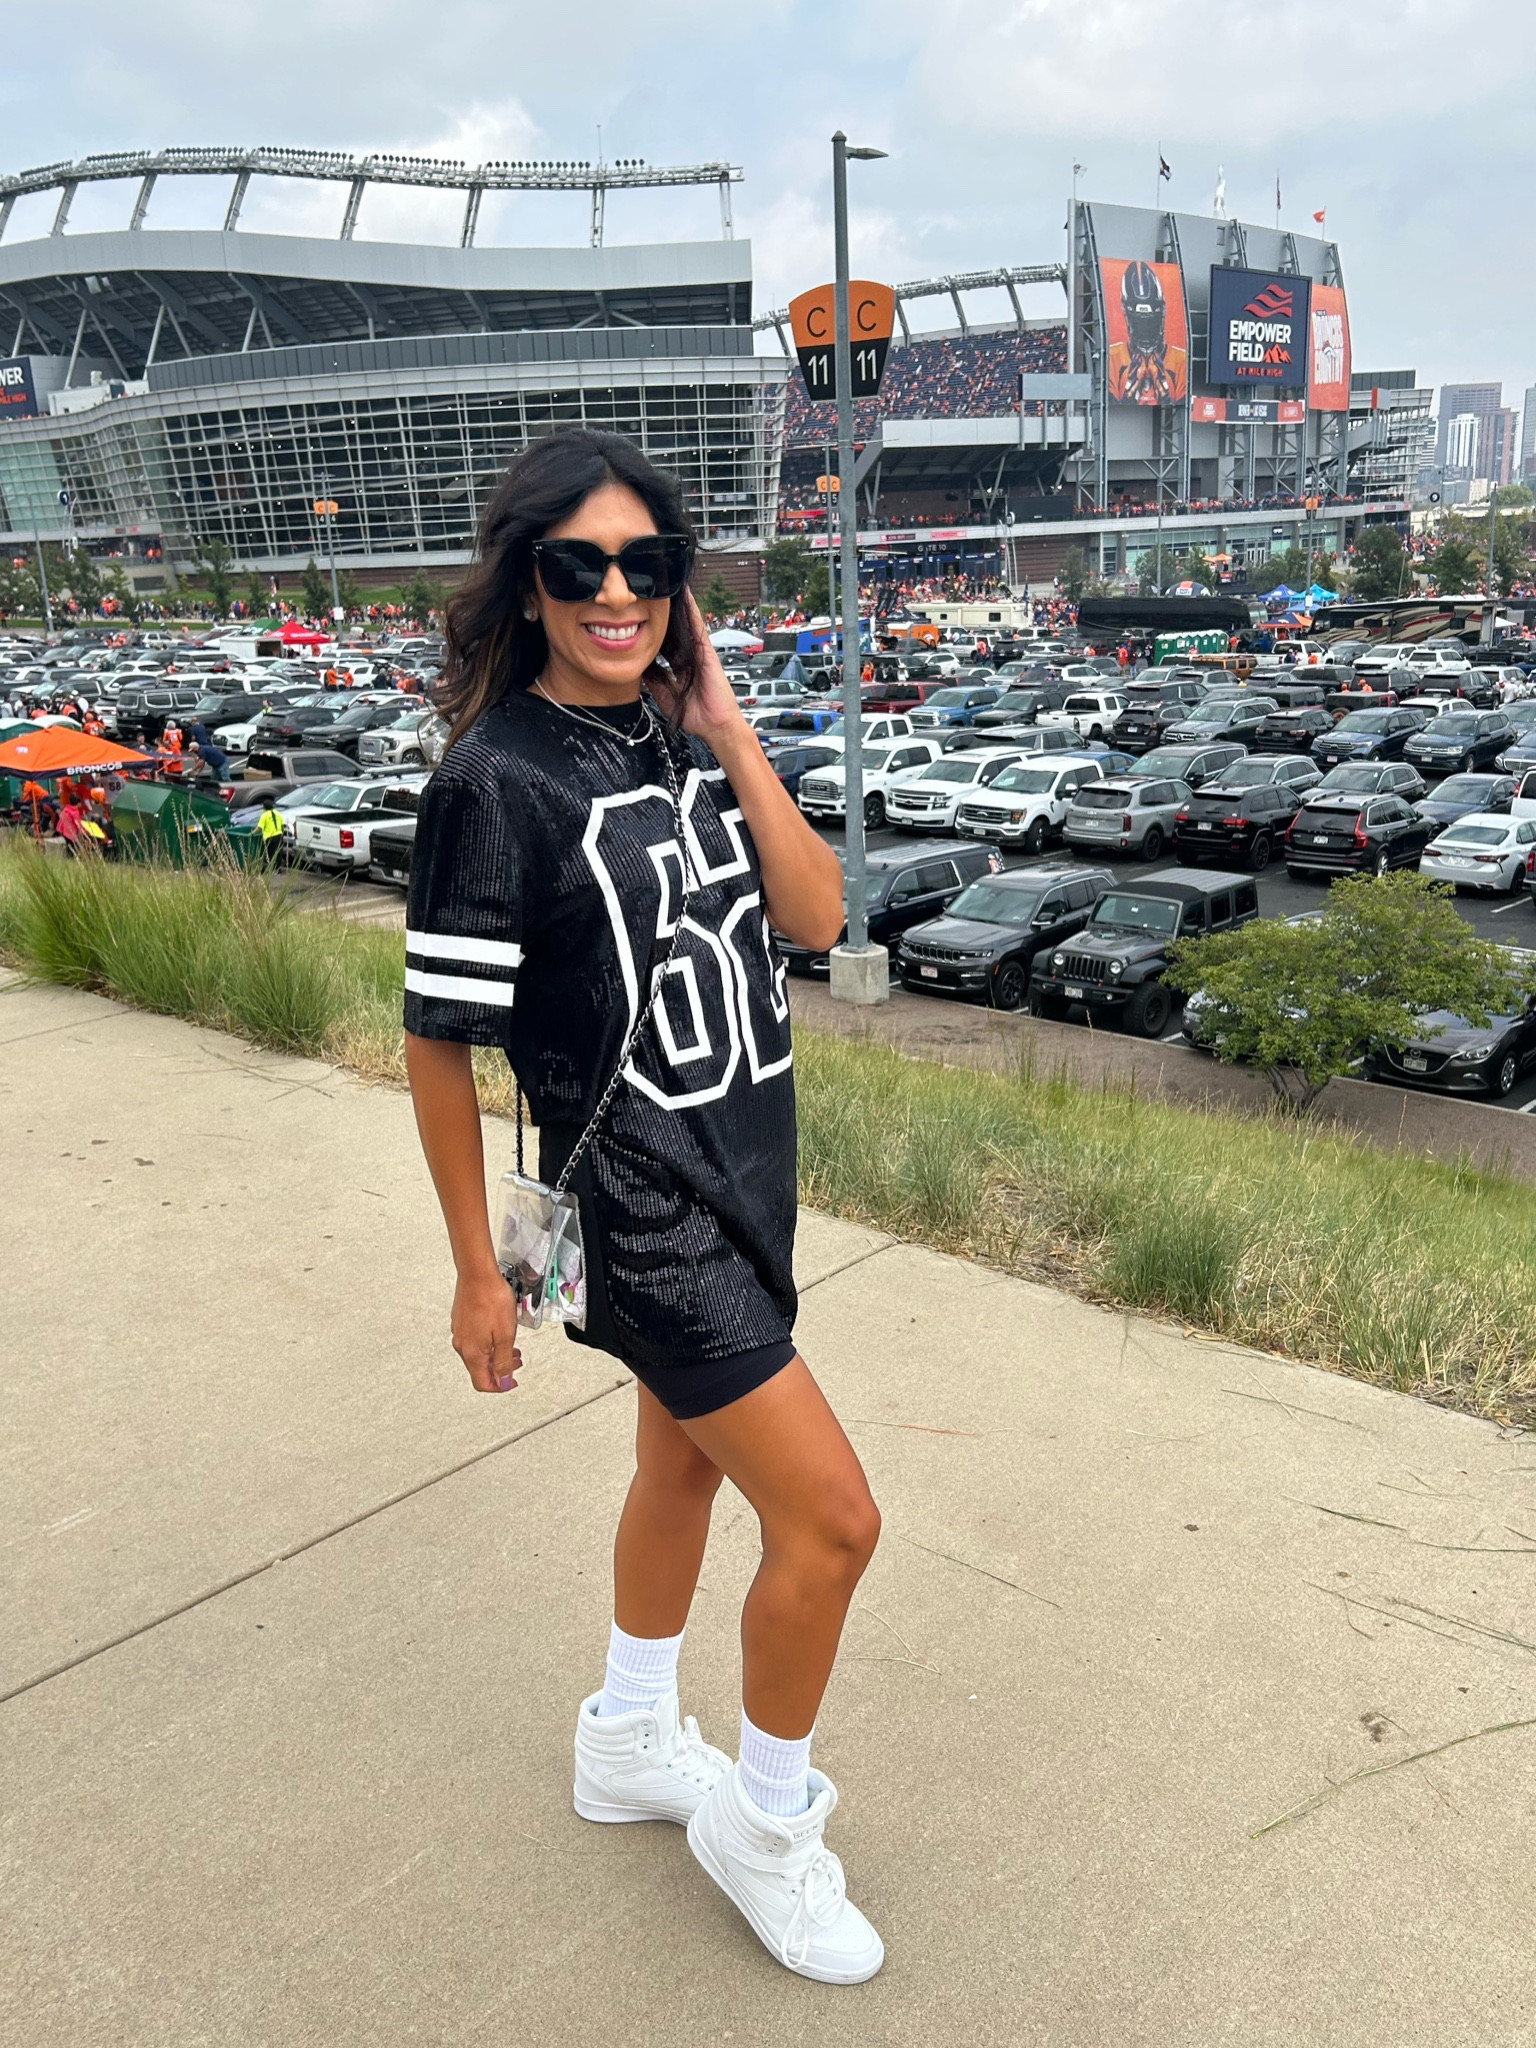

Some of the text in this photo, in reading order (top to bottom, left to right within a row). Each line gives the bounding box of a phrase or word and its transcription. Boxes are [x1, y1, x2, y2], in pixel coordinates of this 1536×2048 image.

[807, 307, 827, 338] C
[857, 300, 877, 331] C
[1229, 320, 1292, 344] EMPOWER
[1229, 342, 1264, 362] FIELD
[808, 354, 828, 386] 11
[856, 348, 877, 381] 11
[1236, 367, 1246, 375] AT
[1248, 367, 1264, 376] MILE
[821, 494, 827, 504] 5
[832, 494, 838, 503] 5
[67, 762, 122, 775] BRONCOS
[109, 782, 122, 792] 58
